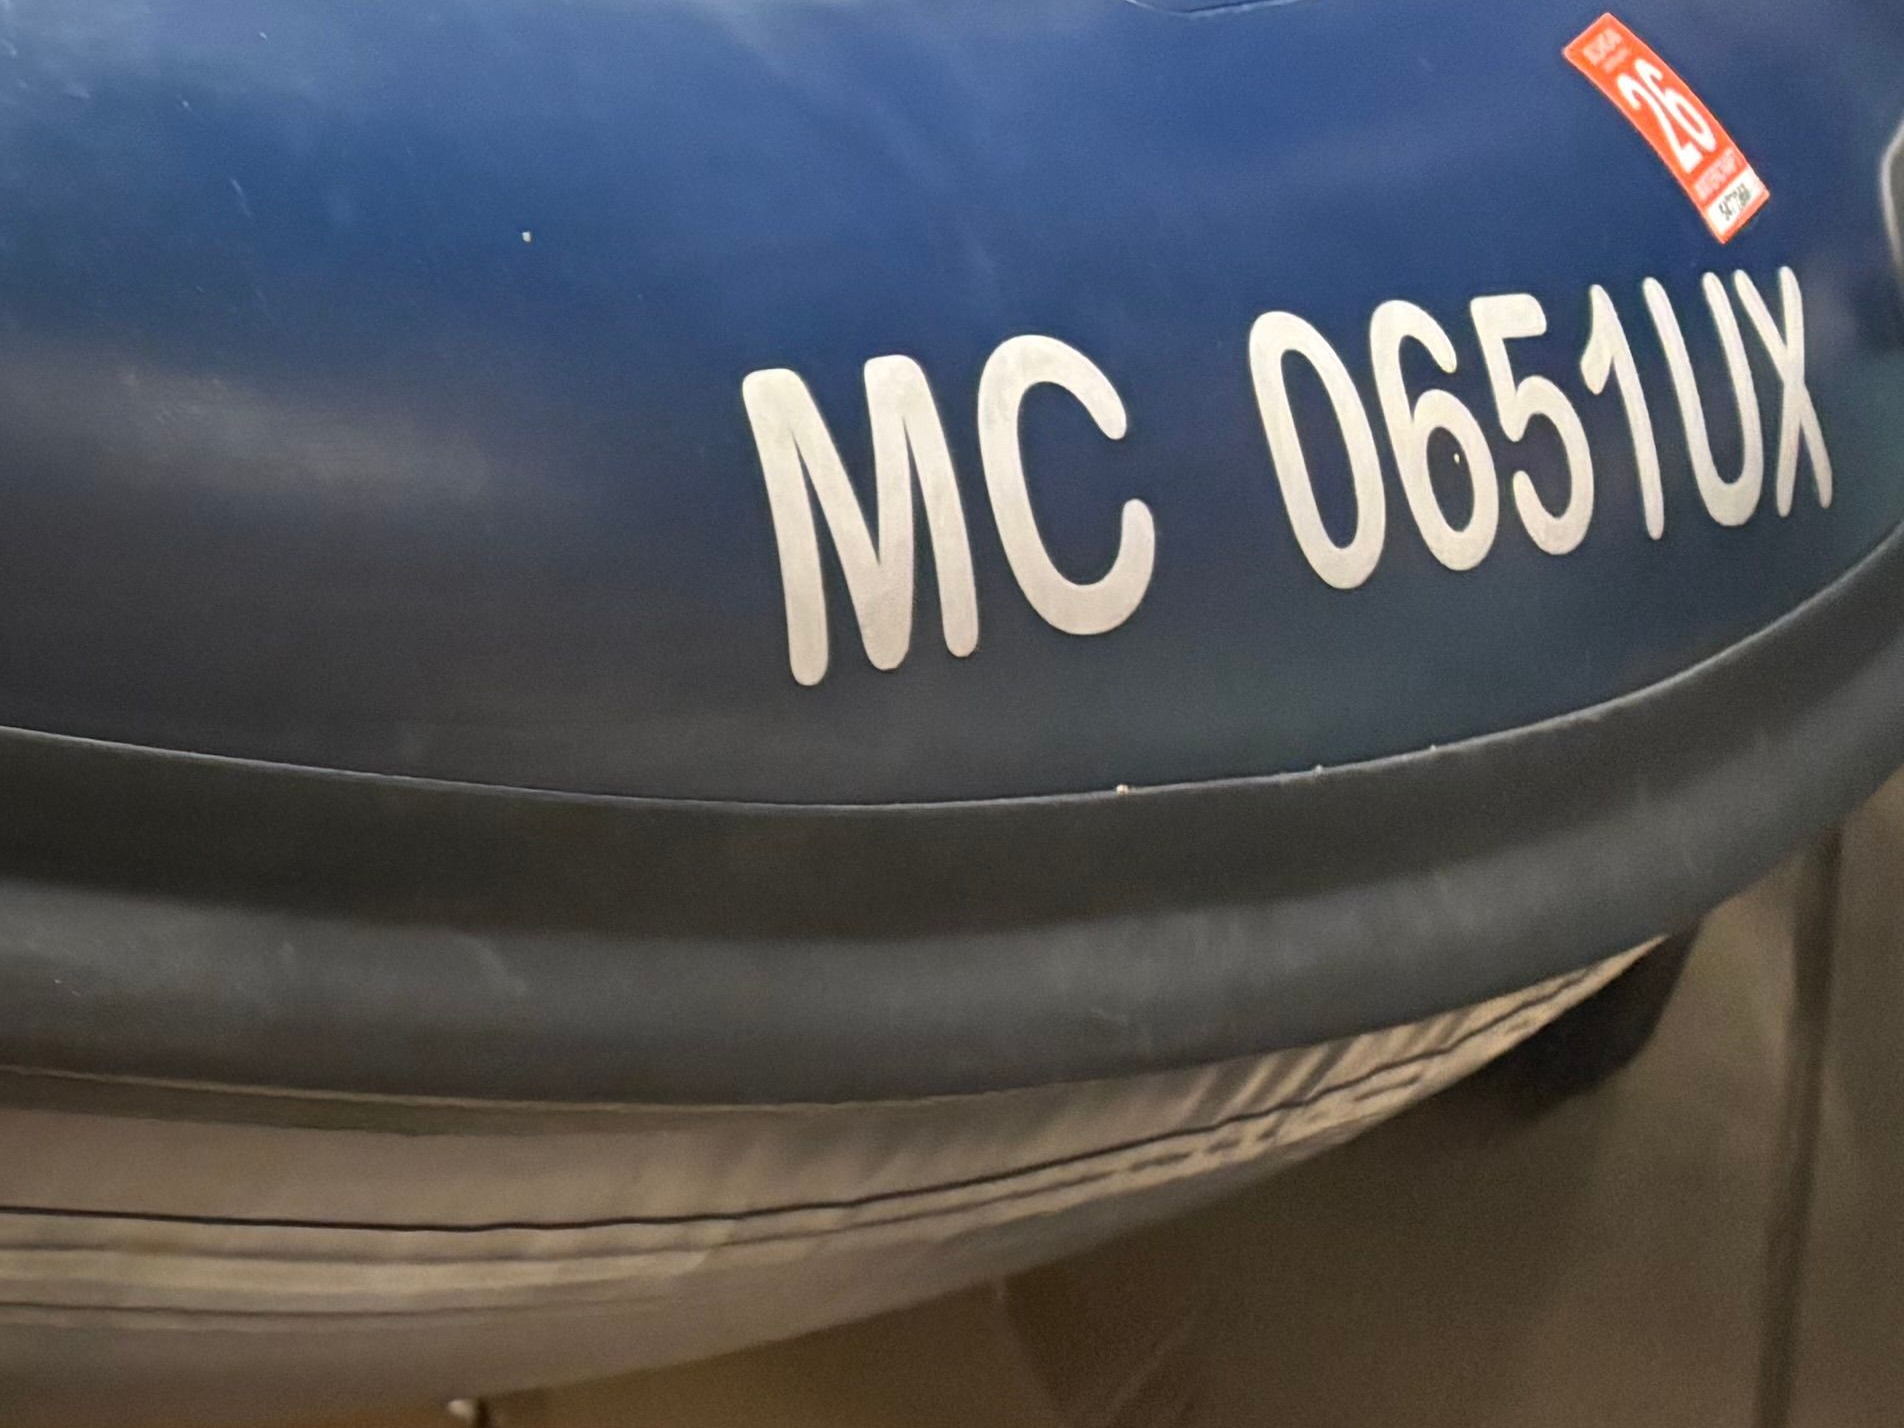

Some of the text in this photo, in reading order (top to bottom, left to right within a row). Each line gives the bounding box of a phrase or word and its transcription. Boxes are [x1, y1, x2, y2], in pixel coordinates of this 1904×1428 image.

[1616, 58, 1717, 174] 26
[742, 266, 1833, 685] MC 0651UX
